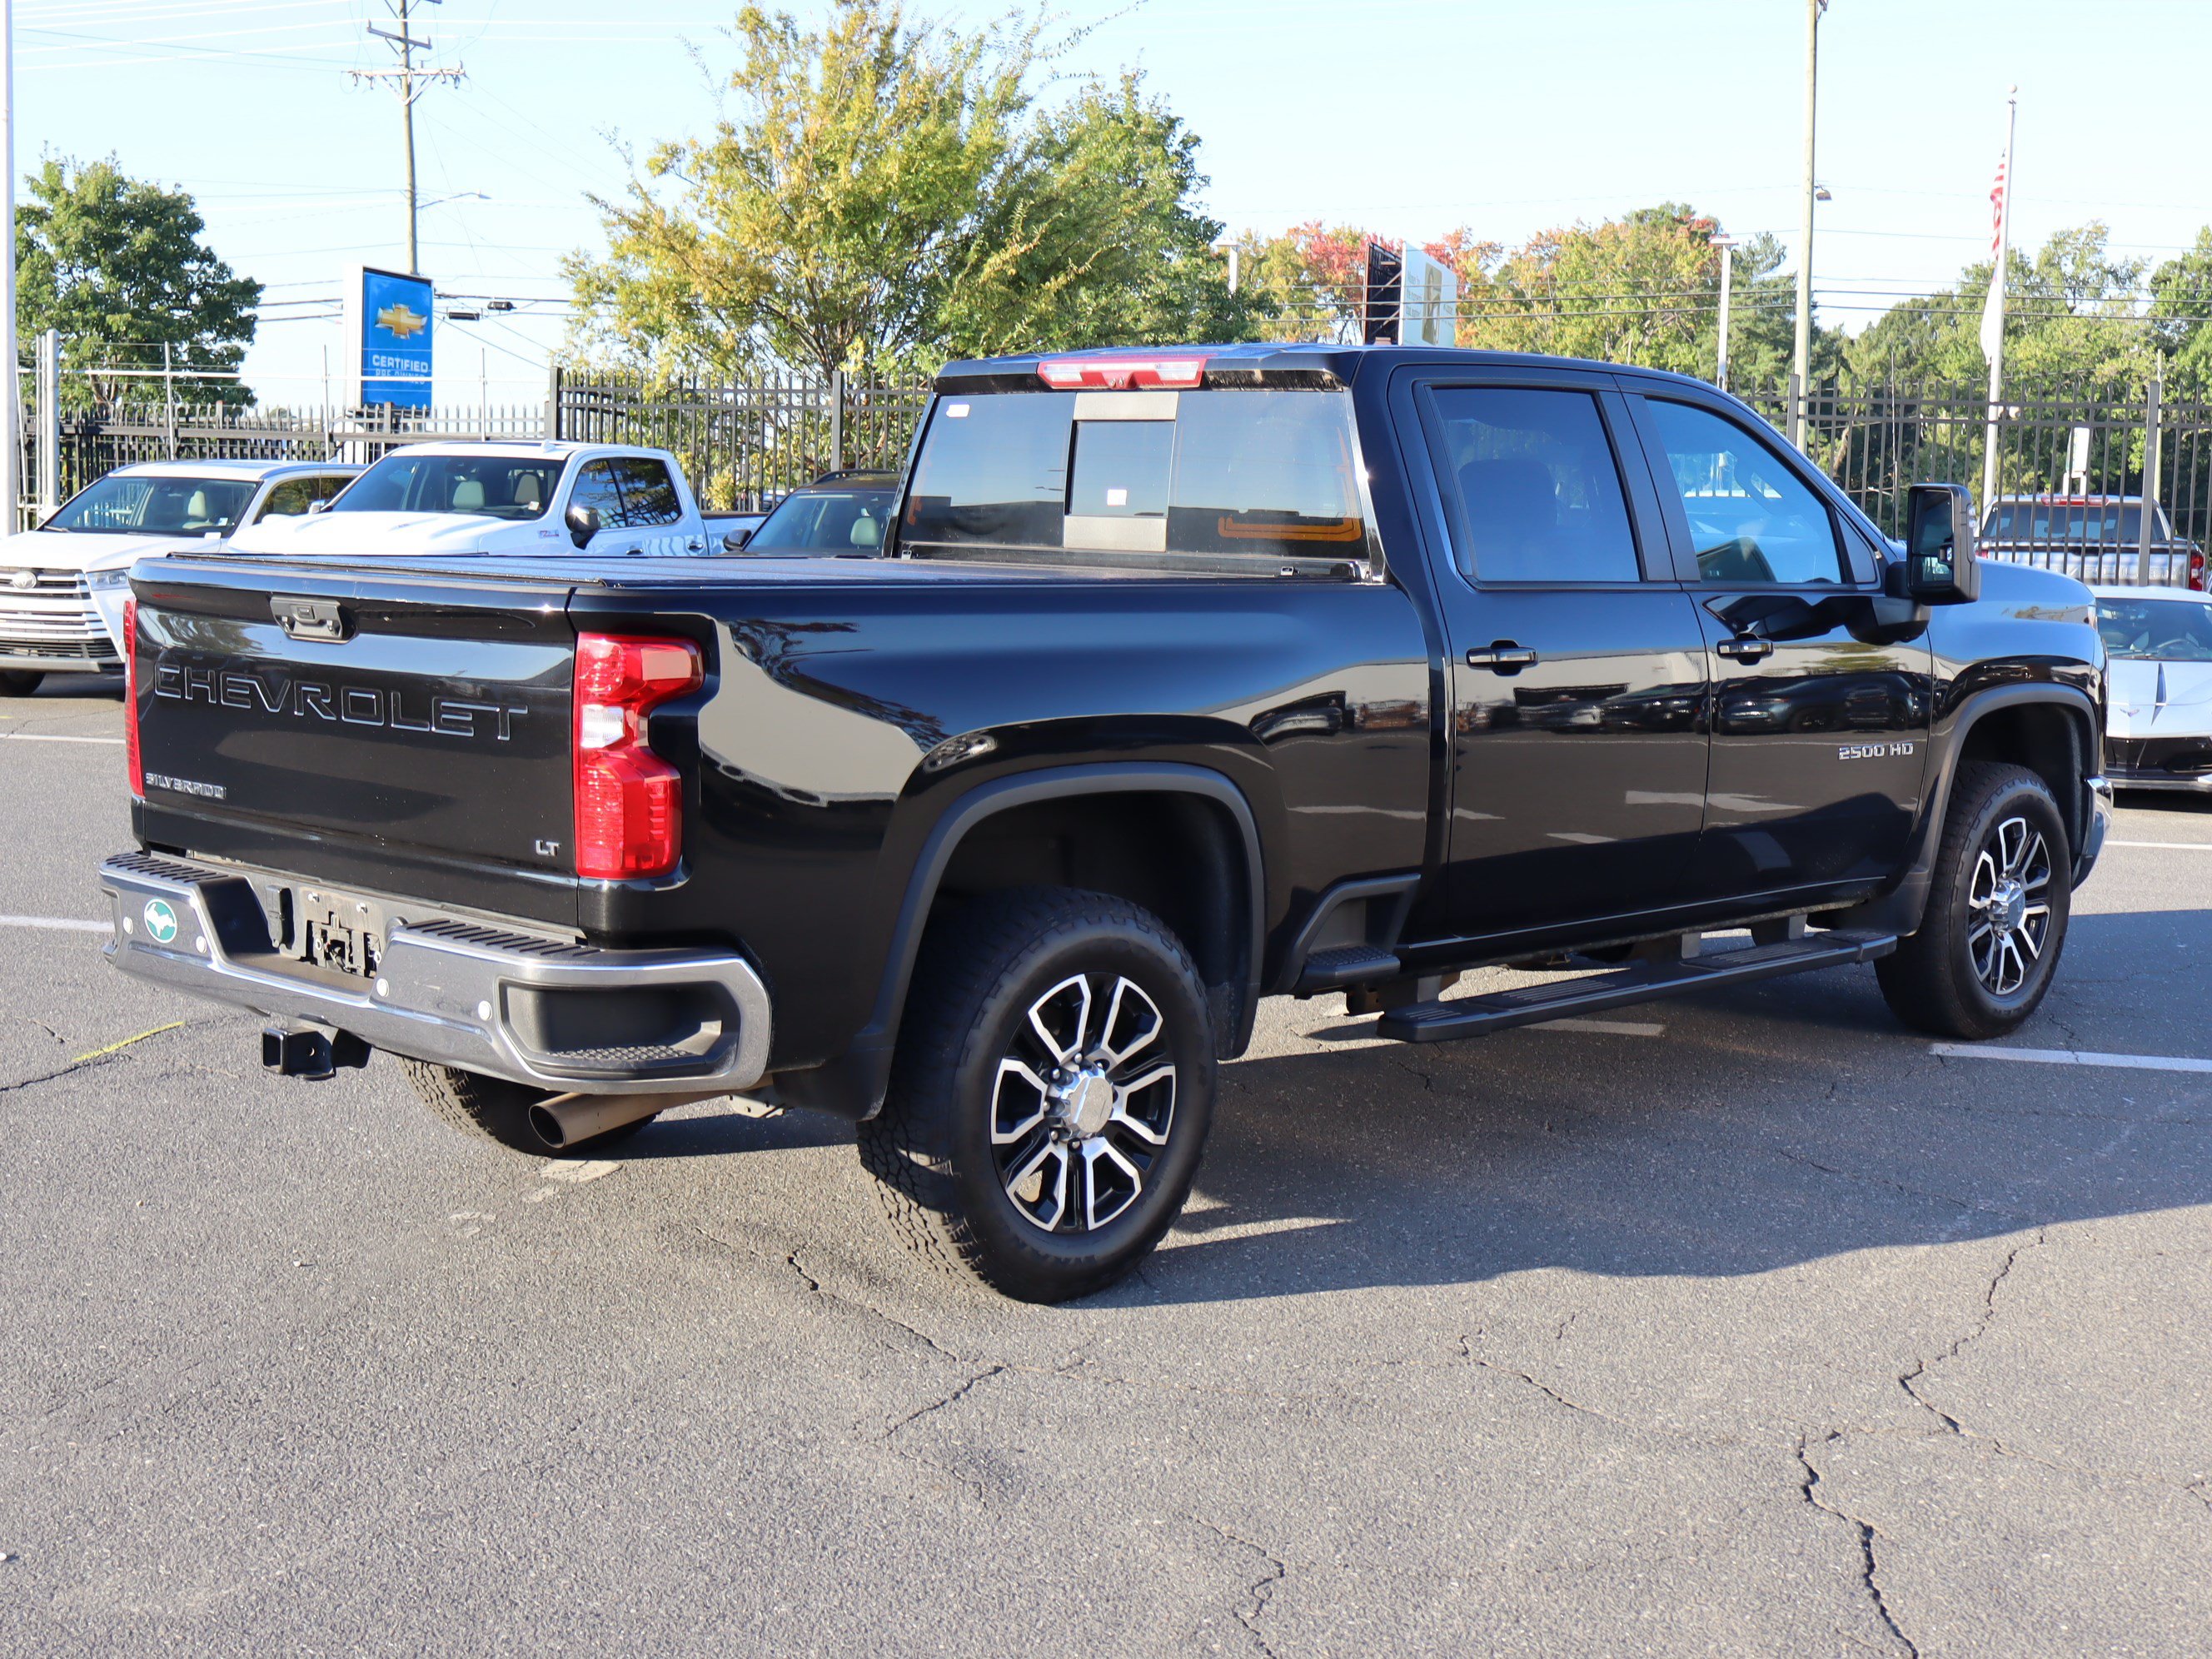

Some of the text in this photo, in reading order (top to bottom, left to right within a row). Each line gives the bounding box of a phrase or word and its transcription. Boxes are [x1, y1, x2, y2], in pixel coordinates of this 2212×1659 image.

[372, 354, 429, 373] CERTIFIED
[154, 663, 529, 741] CHEVROLET
[1838, 743, 1914, 760] 2500 HD
[146, 772, 227, 800] SILVERADO
[536, 839, 560, 857] LT
